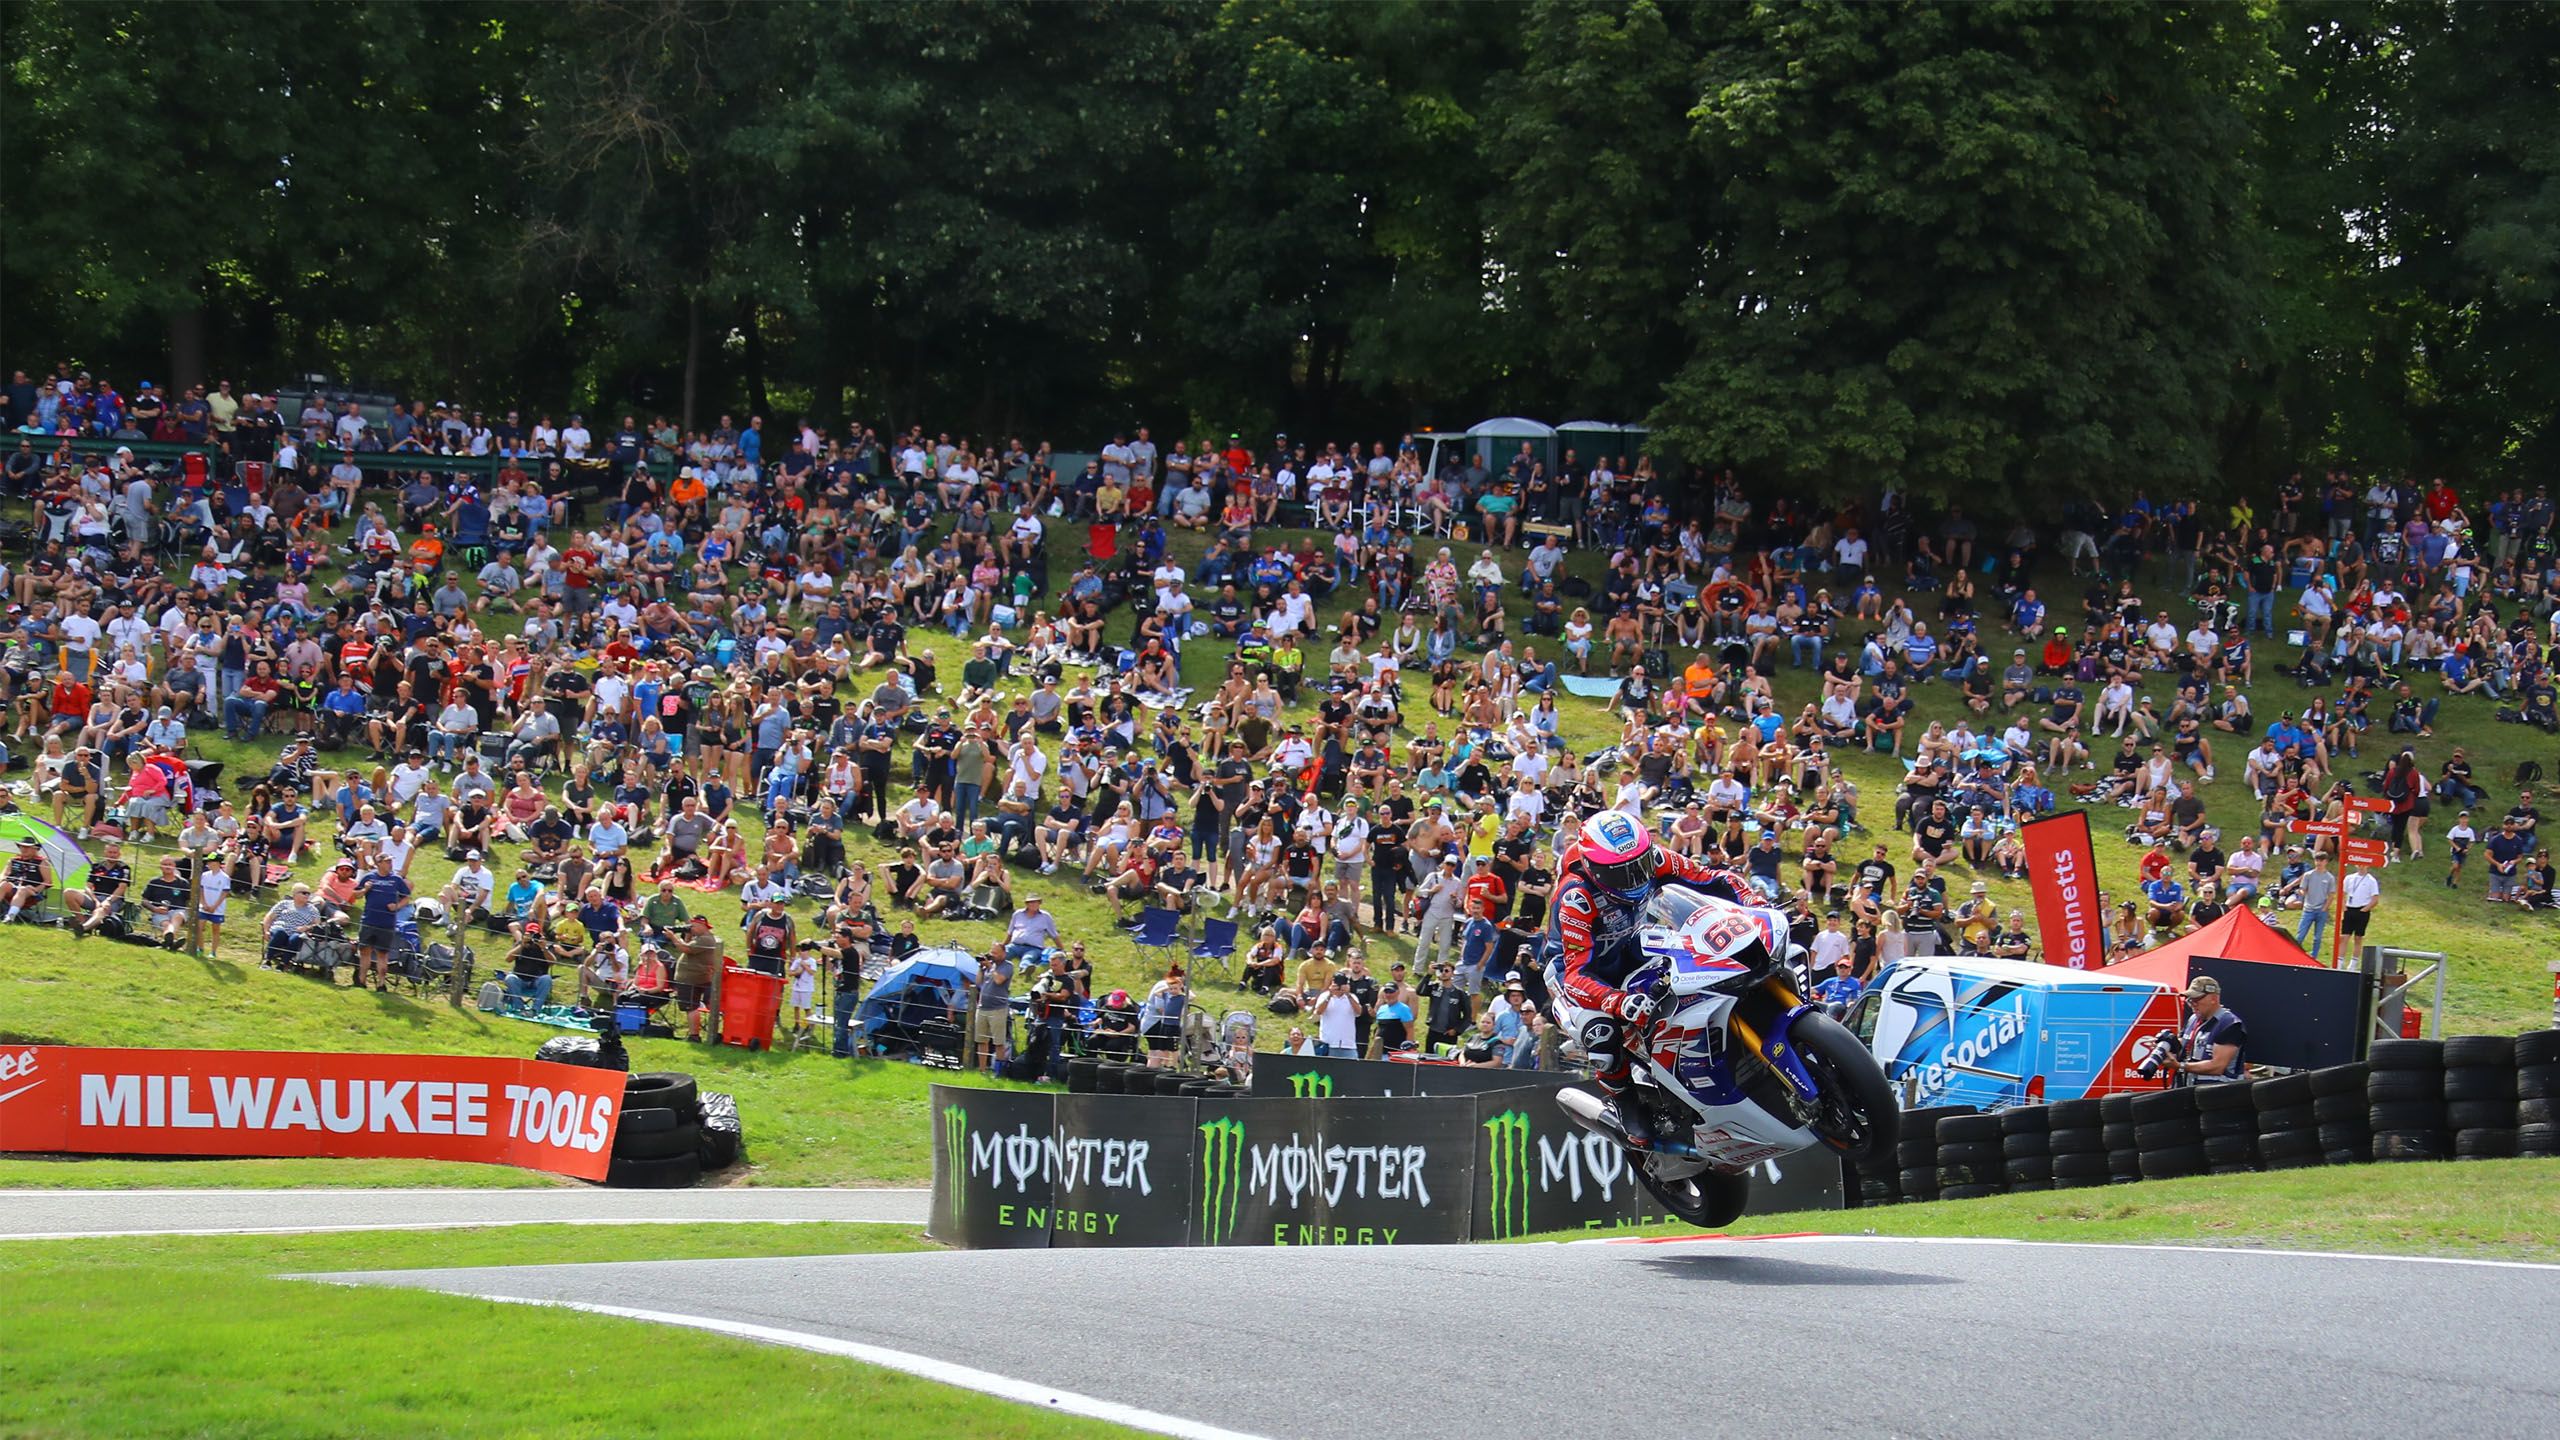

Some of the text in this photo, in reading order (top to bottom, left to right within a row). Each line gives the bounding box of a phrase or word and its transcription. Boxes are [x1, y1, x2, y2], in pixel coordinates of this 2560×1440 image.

[2306, 824, 2340, 833] Footbridge
[1617, 840, 1636, 853] SHOEI
[2054, 849, 2086, 970] Bennetts
[1563, 929, 1584, 941] MOTUL
[1702, 915, 1755, 954] 68
[80, 1074, 612, 1153] MILWAUKEE TOOLS
[971, 1123, 1152, 1196] MONSTER
[1250, 1132, 1431, 1209] MONSTER
[999, 1205, 1120, 1235] ENERGY
[1274, 1223, 1399, 1246] ENERGY
